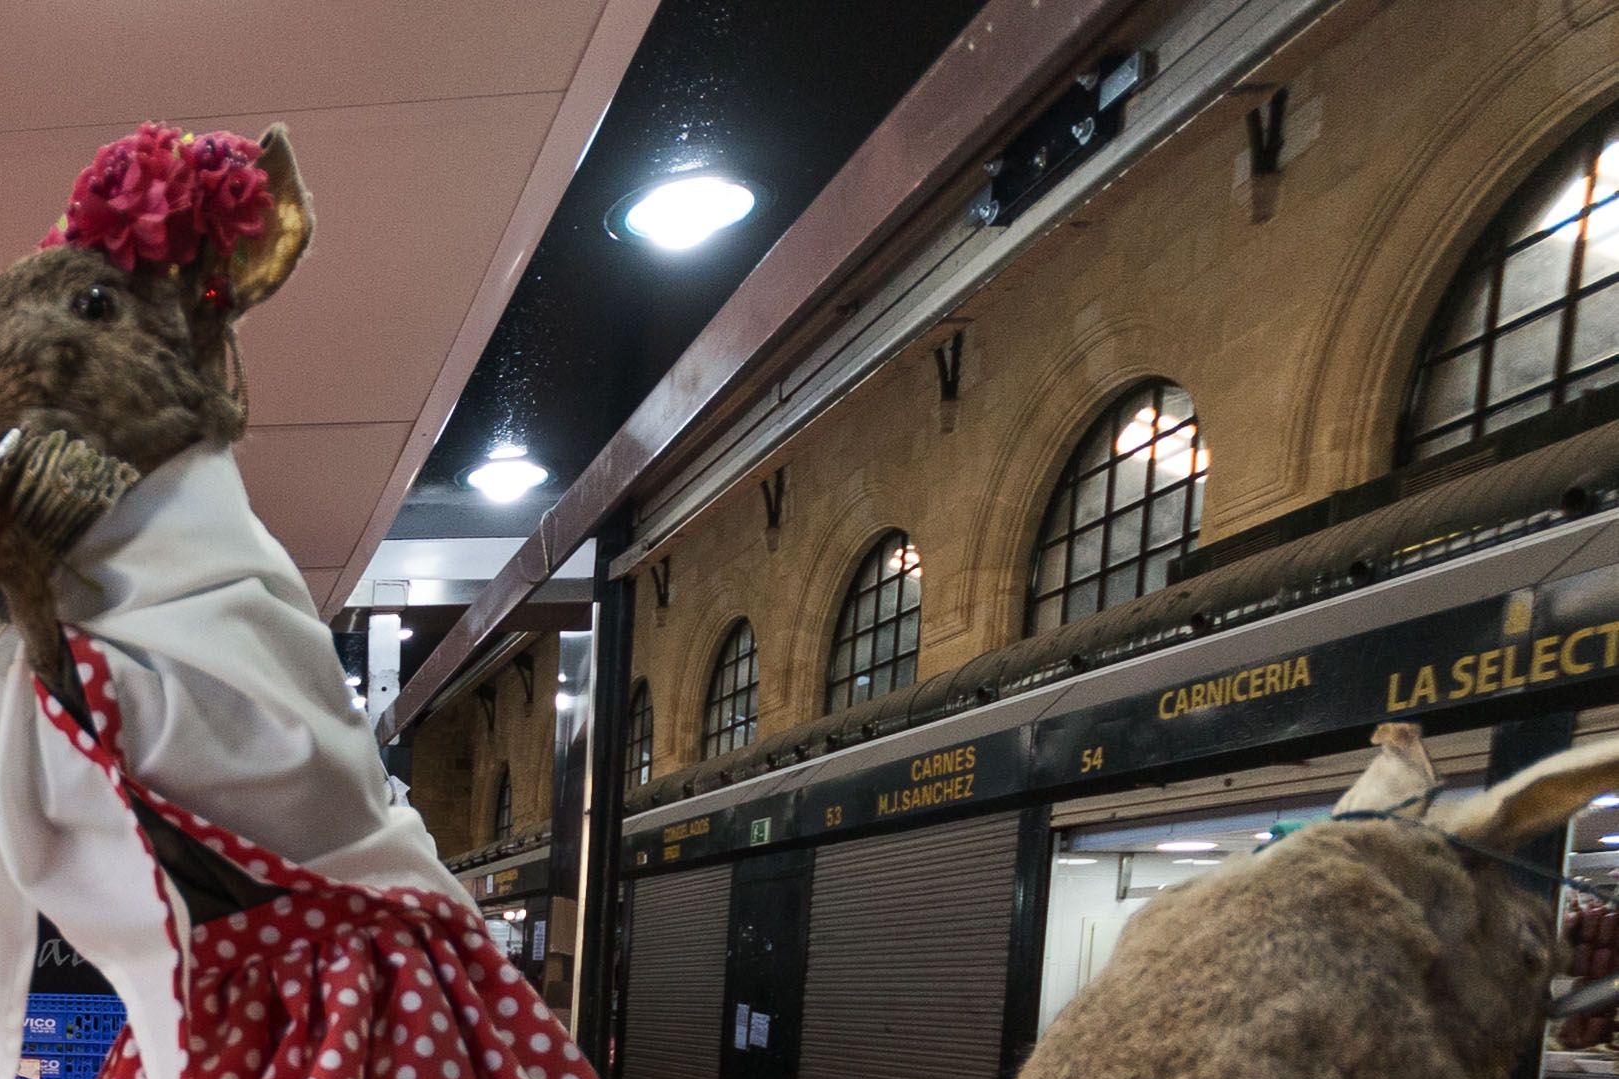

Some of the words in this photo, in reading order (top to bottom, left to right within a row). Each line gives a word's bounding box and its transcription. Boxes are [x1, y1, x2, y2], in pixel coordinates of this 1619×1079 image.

[1157, 655, 1313, 721] CARNICERIA
[1385, 664, 1438, 713] LA
[1447, 621, 1619, 700] SELECT
[910, 745, 977, 782] CARNES
[1080, 746, 1104, 774] 54
[823, 805, 843, 828] 53
